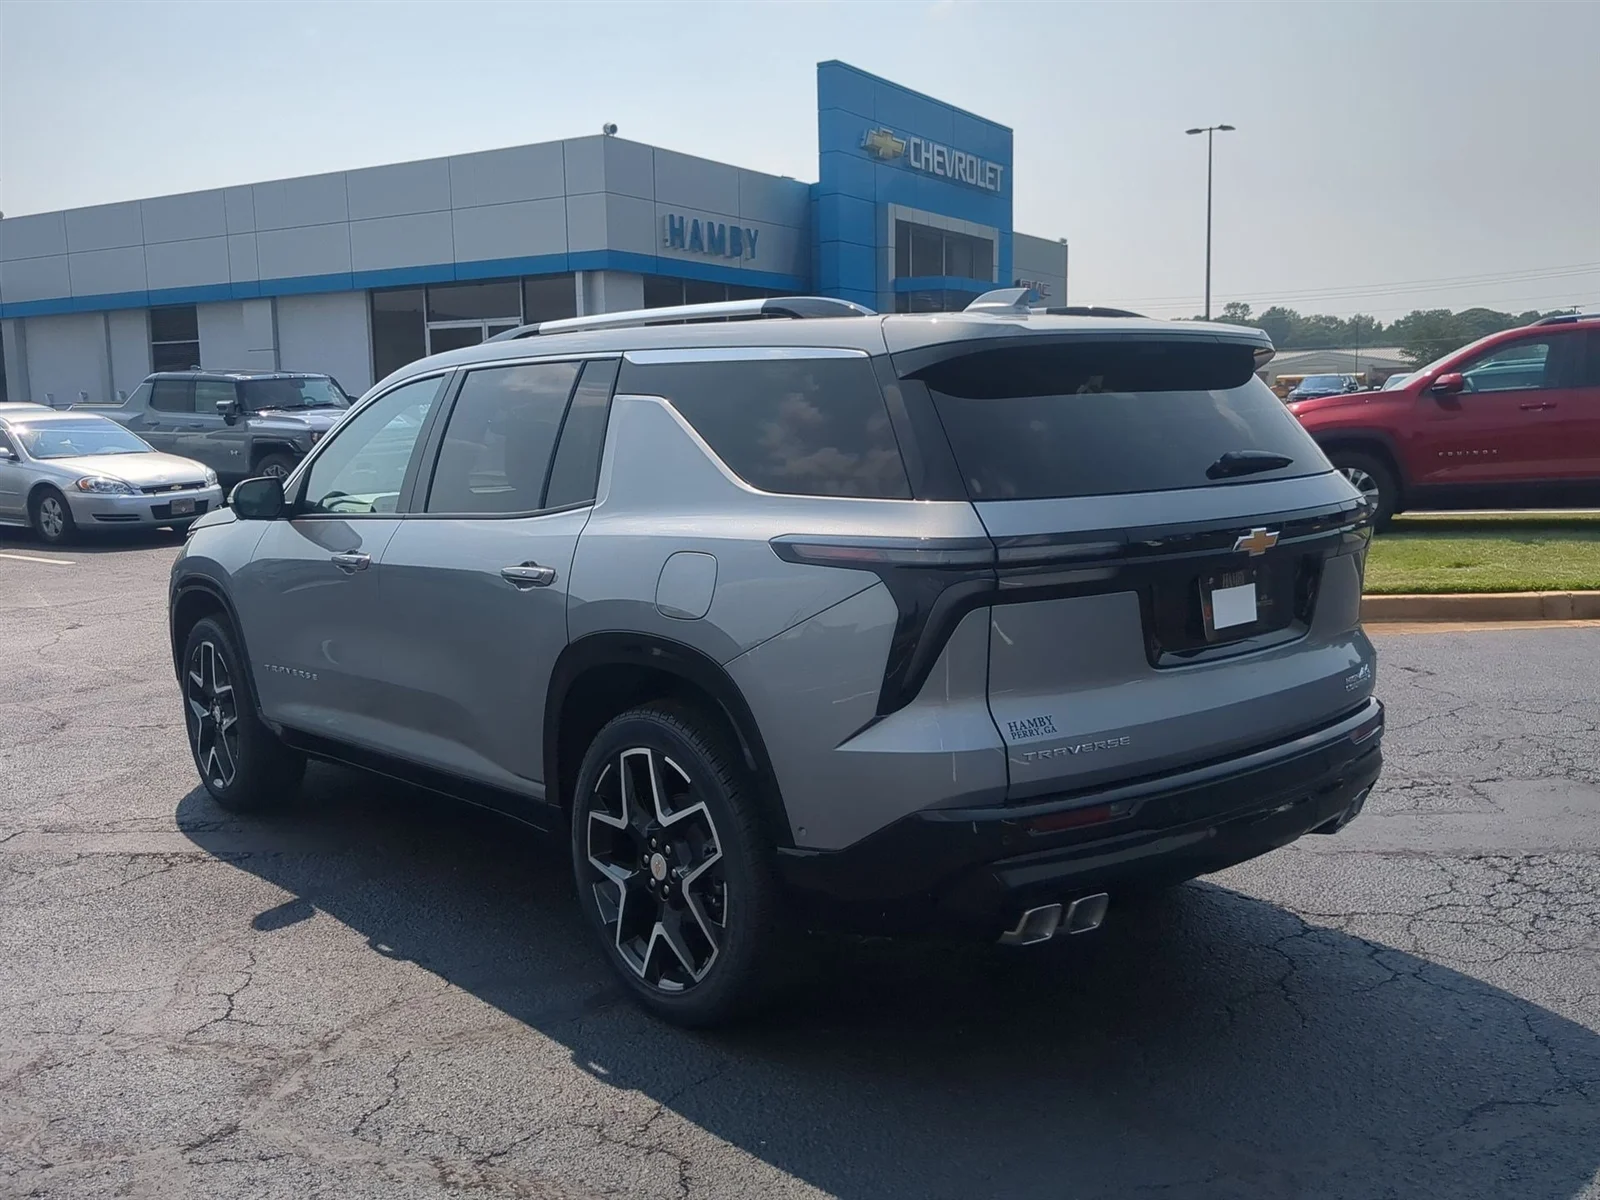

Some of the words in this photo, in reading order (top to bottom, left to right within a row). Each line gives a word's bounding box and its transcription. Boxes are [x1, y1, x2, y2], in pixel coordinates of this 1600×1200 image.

[909, 136, 1004, 193] CHEVROLET
[666, 213, 759, 260] HAMBY
[263, 664, 318, 681] TRAVERSE
[1007, 715, 1054, 732] HAMBY
[1022, 735, 1131, 761] TRAVERSE
